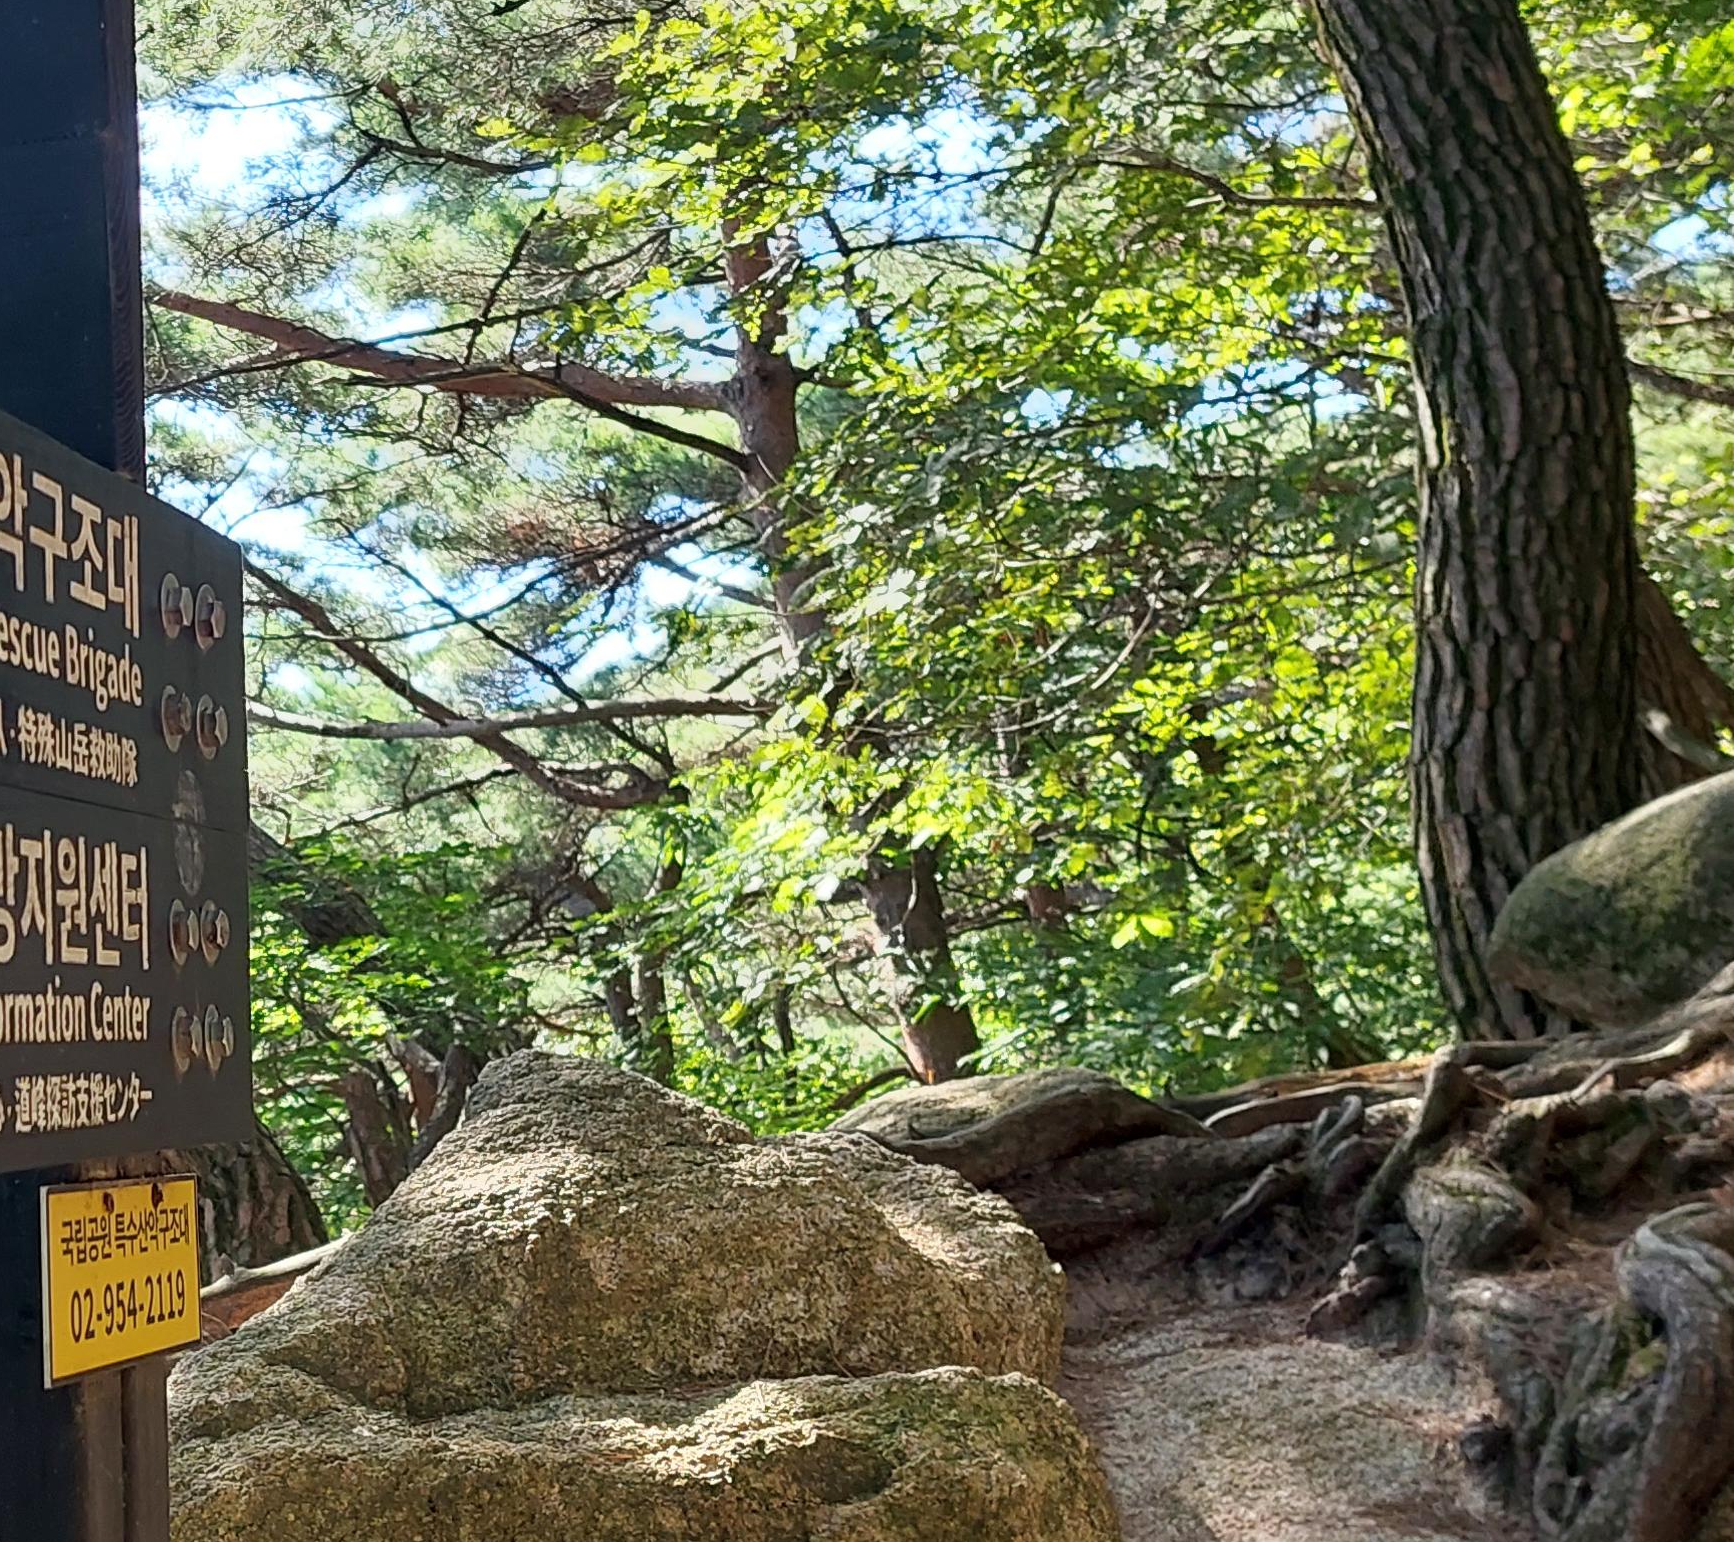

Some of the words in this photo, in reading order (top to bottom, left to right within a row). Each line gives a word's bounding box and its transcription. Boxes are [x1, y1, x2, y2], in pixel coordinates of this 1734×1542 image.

[65, 623, 143, 712] Brigade
[89, 979, 152, 1043] Center
[60, 1212, 113, 1266] 국립공원
[114, 1203, 191, 1258] 특수산악구조대
[70, 1268, 186, 1344] 02-954-2119
